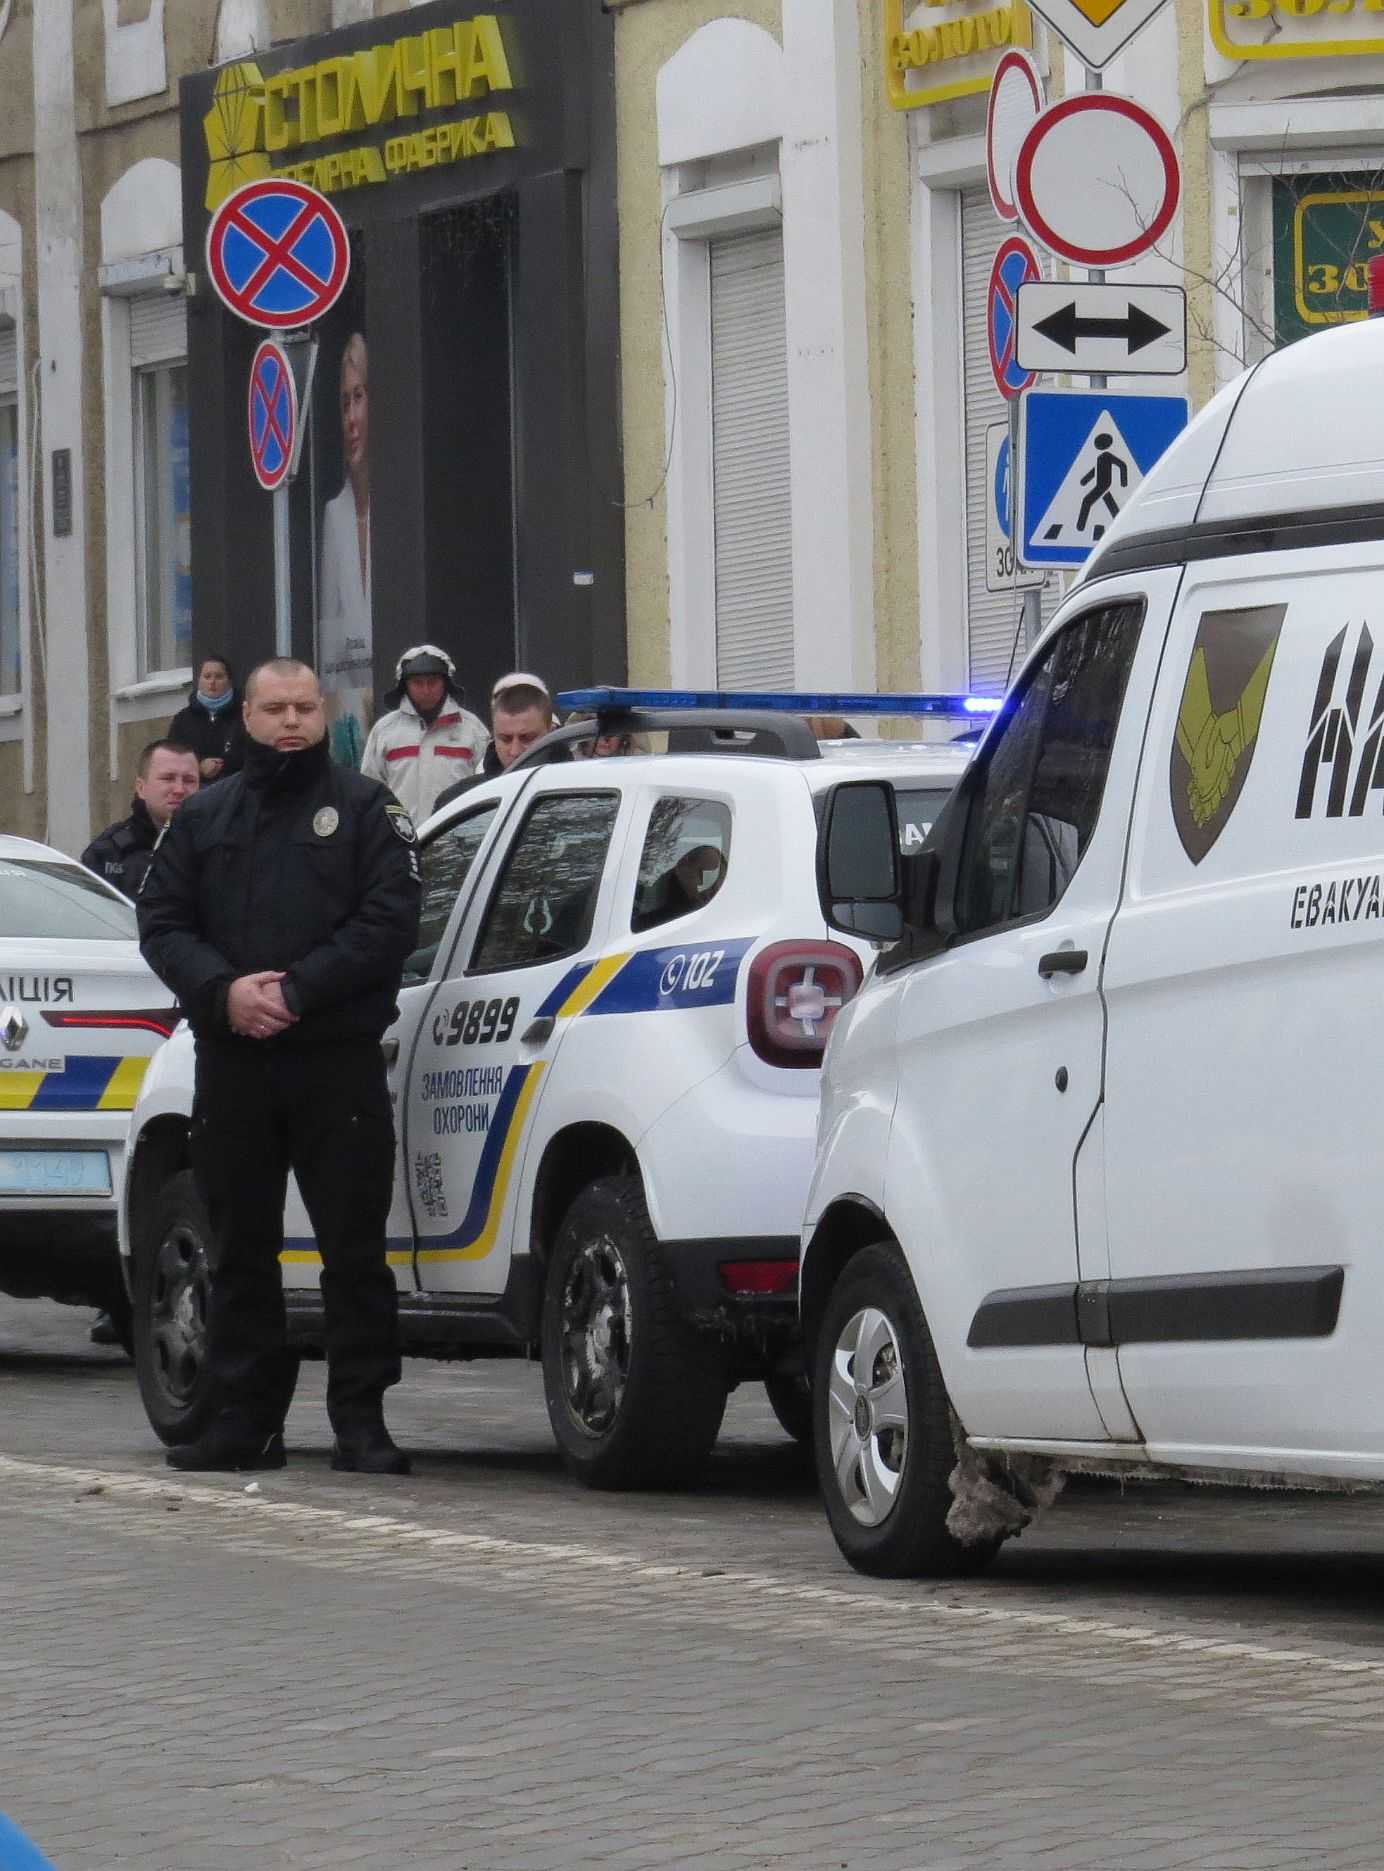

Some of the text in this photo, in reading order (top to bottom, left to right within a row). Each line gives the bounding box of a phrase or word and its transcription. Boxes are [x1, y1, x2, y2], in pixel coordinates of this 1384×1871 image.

[264, 15, 513, 151] СТОЛИЧНА
[385, 112, 515, 174] ФАБРИКА
[682, 949, 725, 991] 102
[446, 997, 520, 1046] 9899
[422, 1066, 503, 1101] ЗАМОВЛЕННЯ
[433, 1103, 489, 1134] ОХОРОНИ
